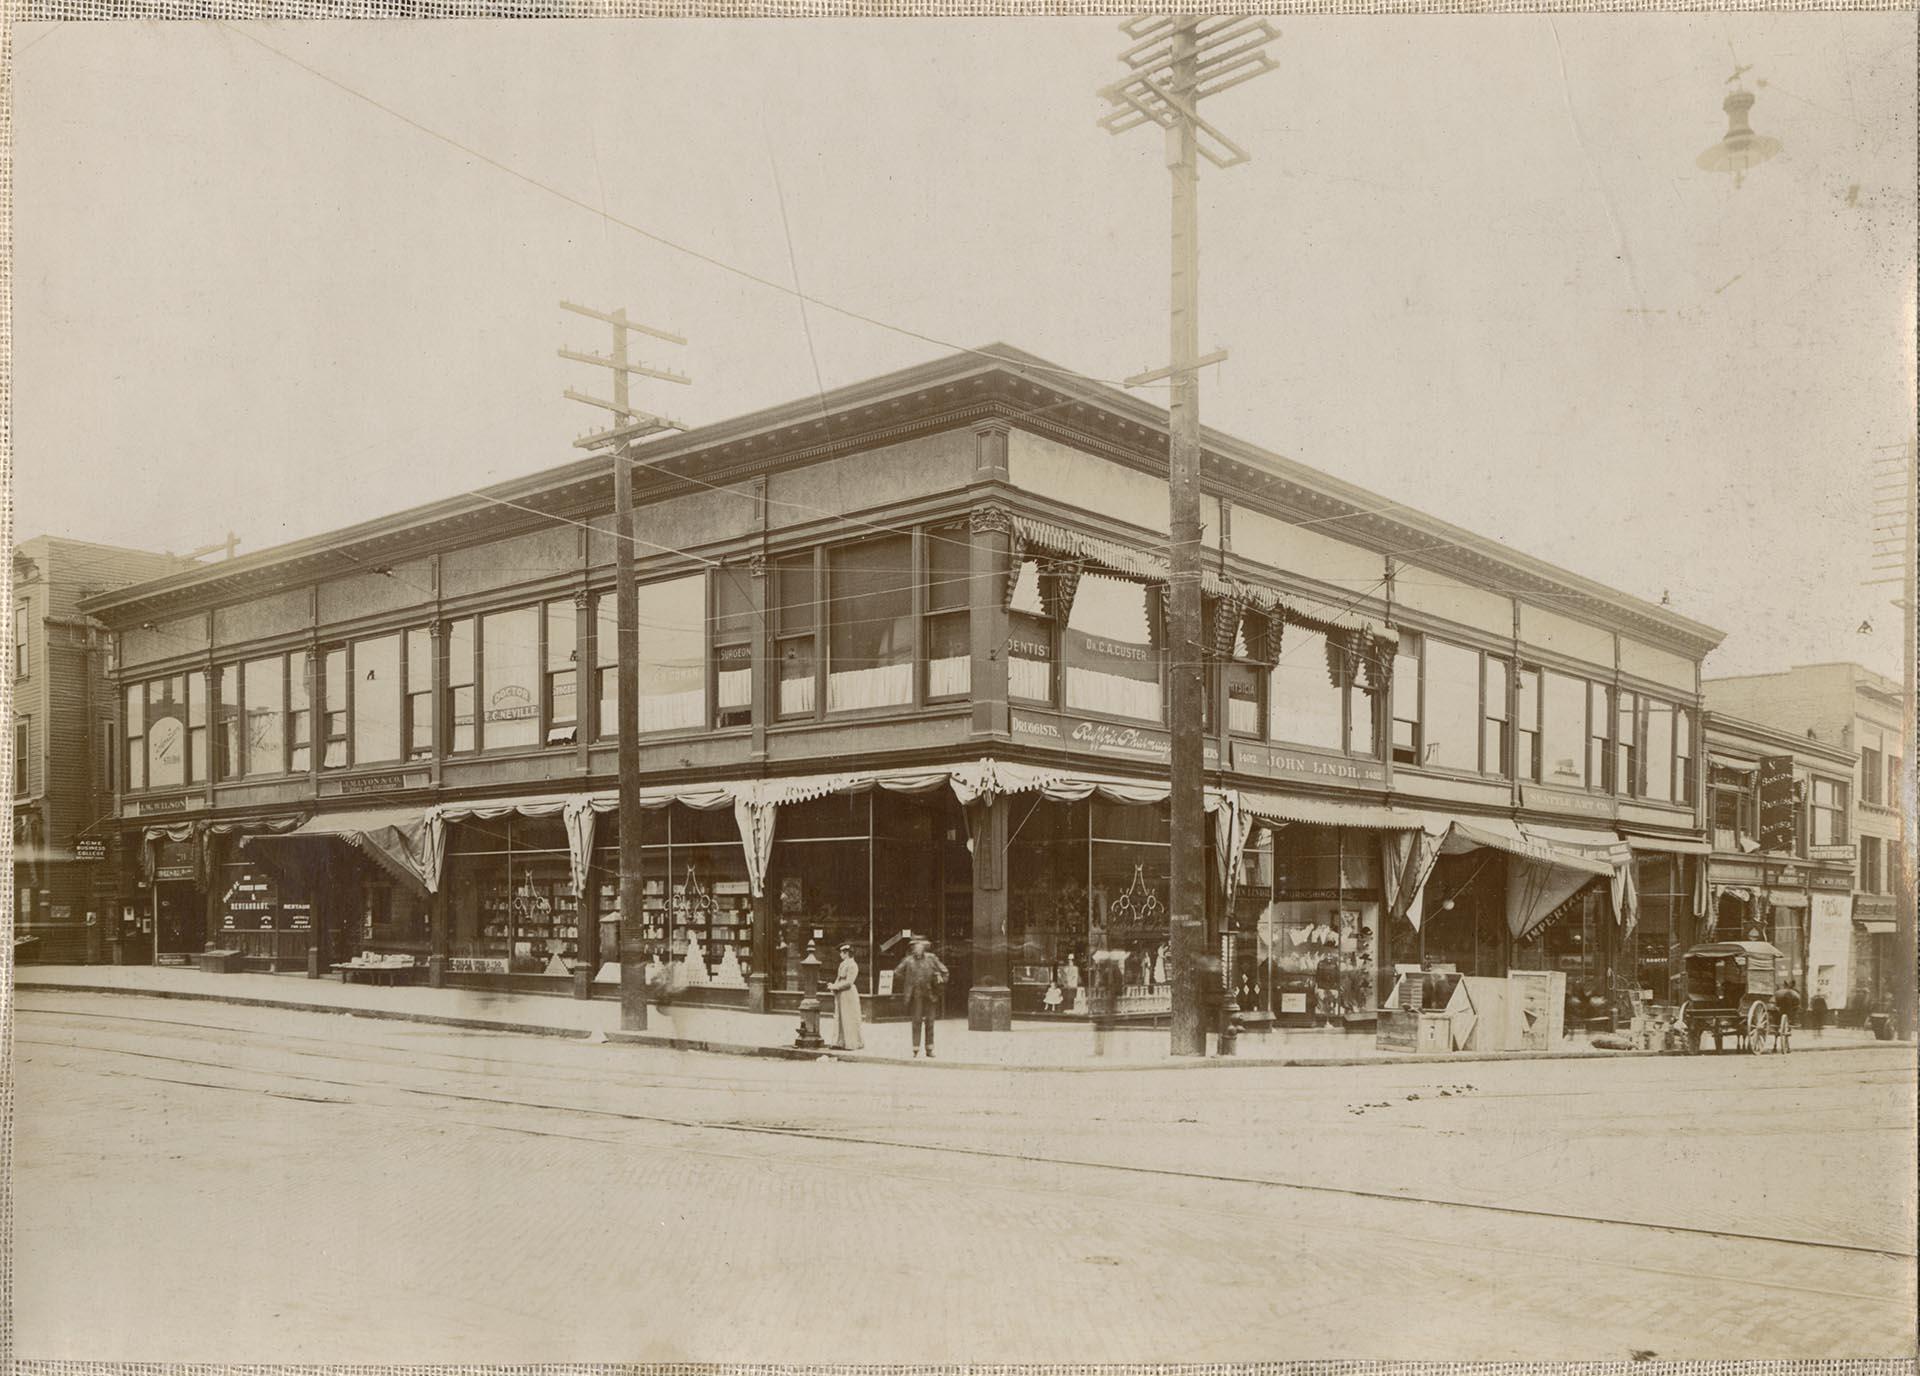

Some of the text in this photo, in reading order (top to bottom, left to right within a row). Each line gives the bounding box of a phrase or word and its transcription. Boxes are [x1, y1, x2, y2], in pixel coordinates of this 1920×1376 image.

[720, 647, 751, 660] SURGEON
[1008, 639, 1050, 657] DENTIST
[495, 686, 529, 702] DOCTOR
[1266, 755, 1305, 771] JOHN
